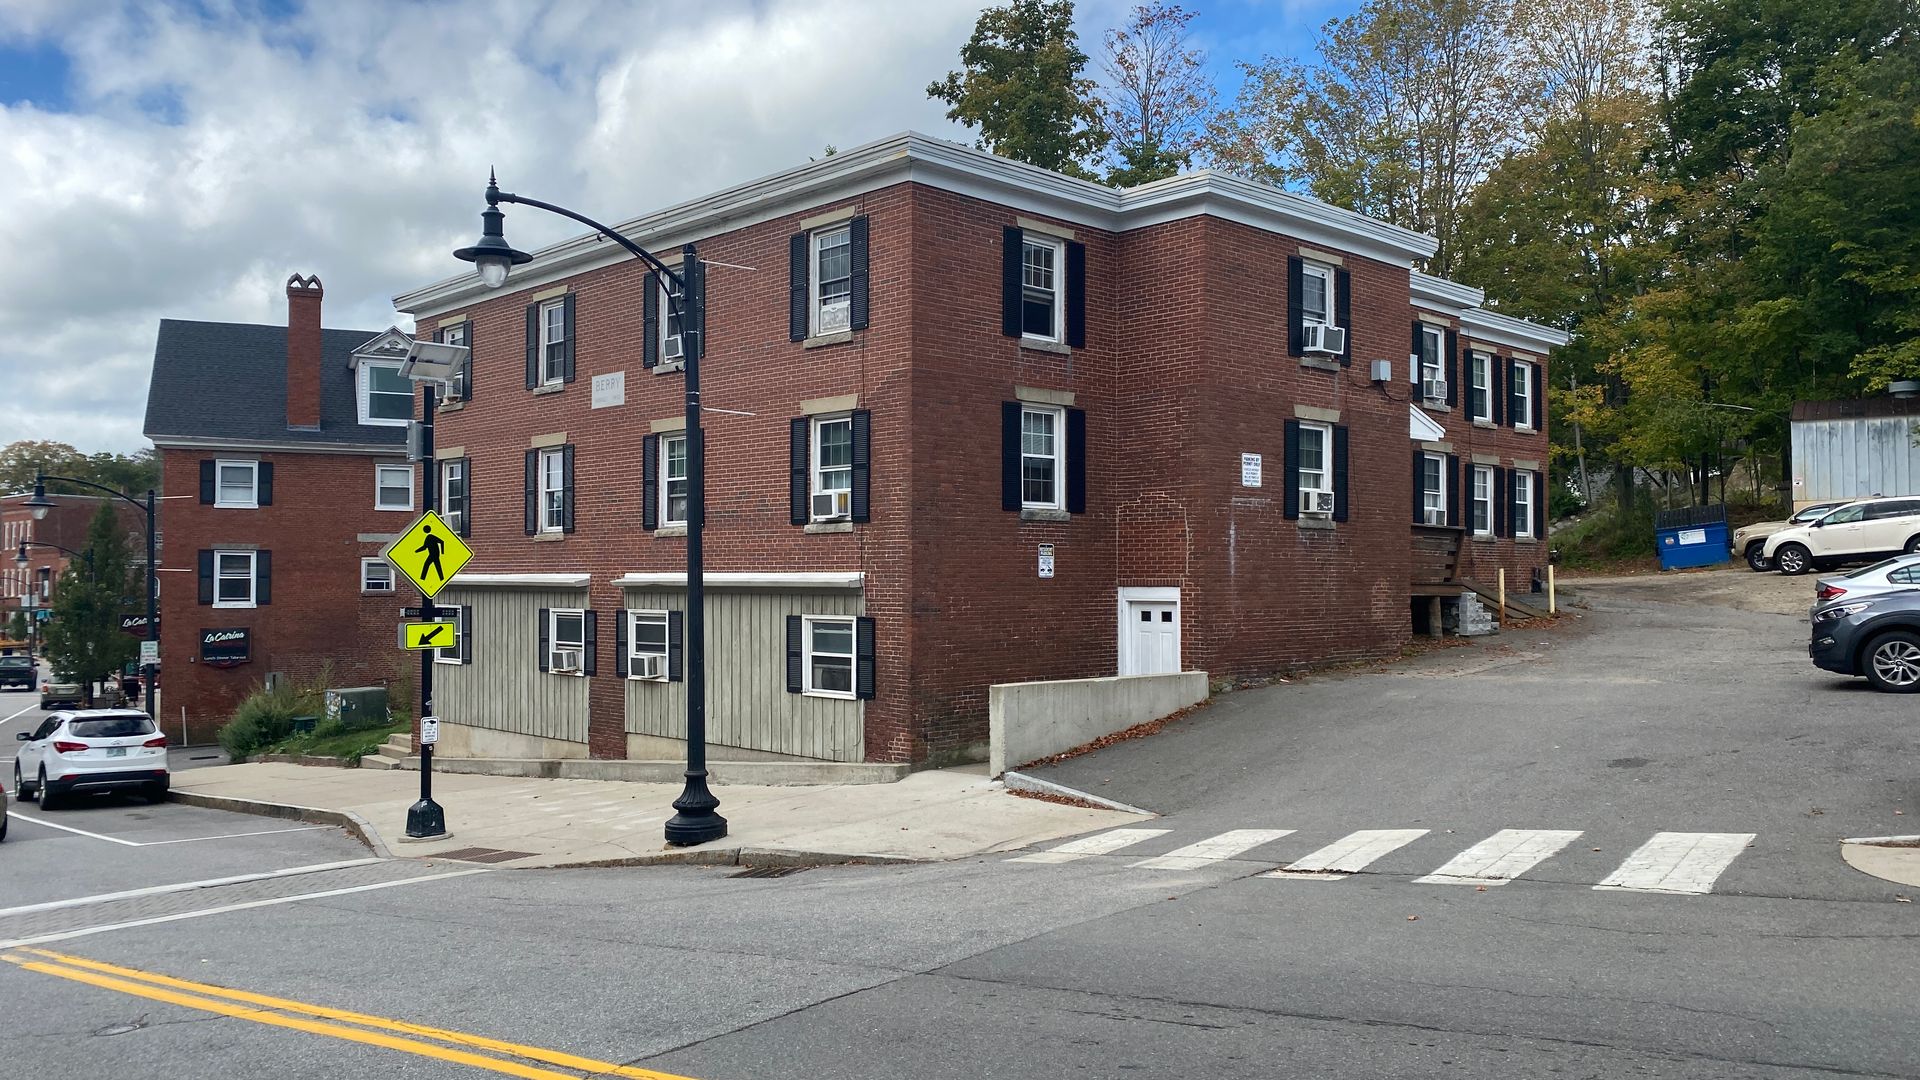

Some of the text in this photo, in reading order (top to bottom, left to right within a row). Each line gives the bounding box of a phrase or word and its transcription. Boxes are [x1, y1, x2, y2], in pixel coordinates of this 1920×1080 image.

[596, 376, 621, 392] BERRY
[122, 618, 131, 627] La
[204, 631, 245, 643] La Catrina
